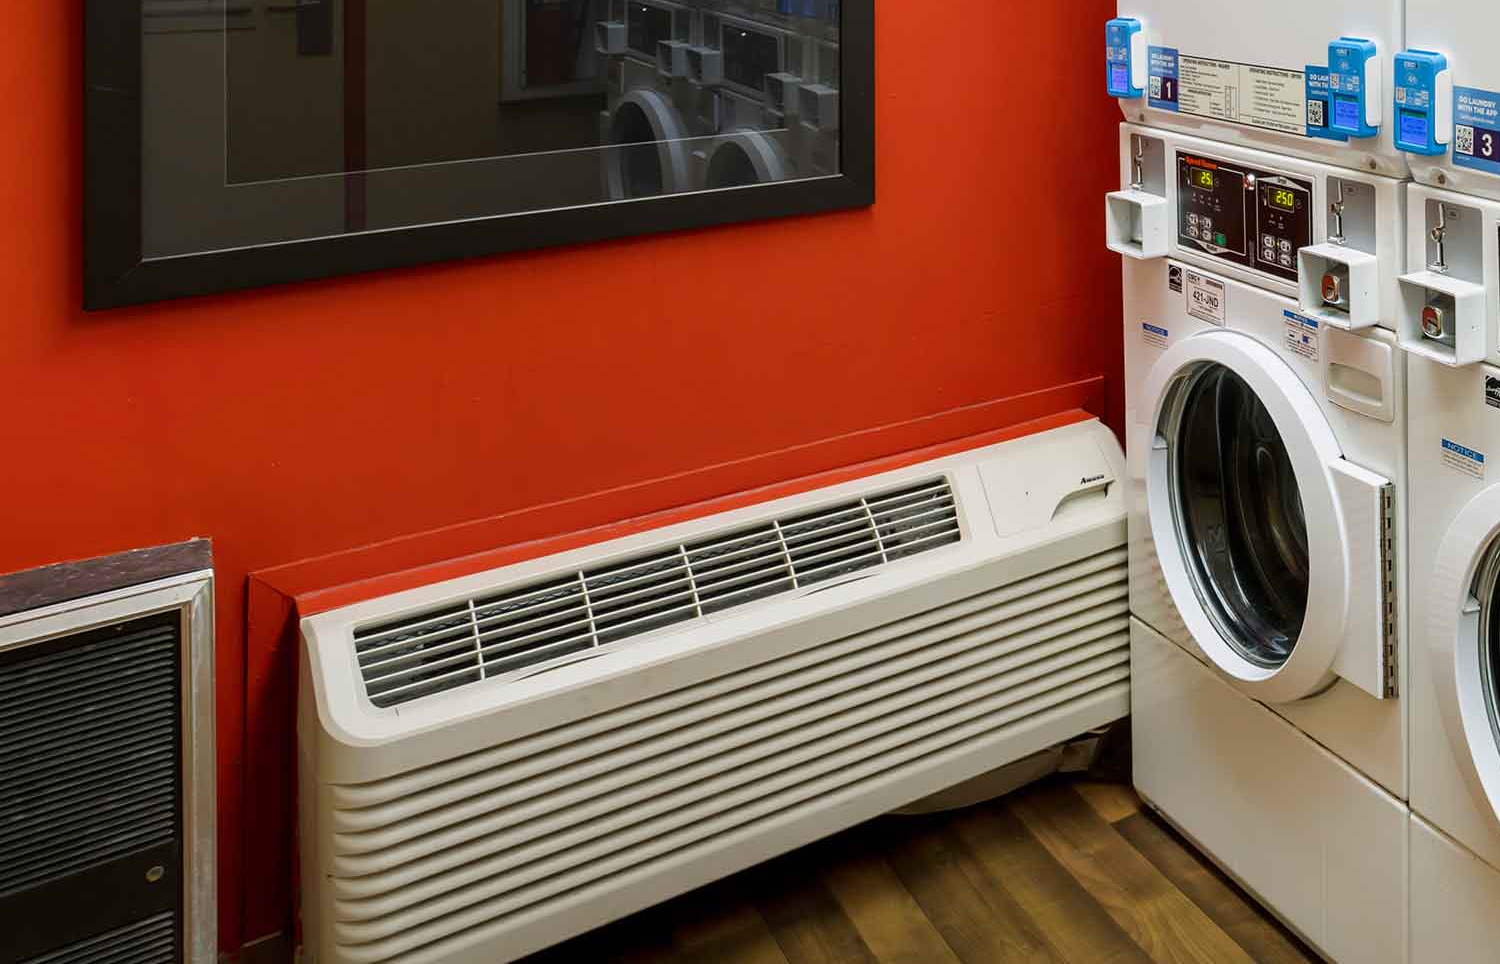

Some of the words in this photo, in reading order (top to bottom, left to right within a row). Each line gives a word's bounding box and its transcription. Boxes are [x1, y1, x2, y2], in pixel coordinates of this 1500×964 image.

[1166, 81, 1172, 99] 1
[1481, 133, 1493, 156] 3
[1276, 190, 1294, 207] 250
[1193, 290, 1219, 307] 421-JND
